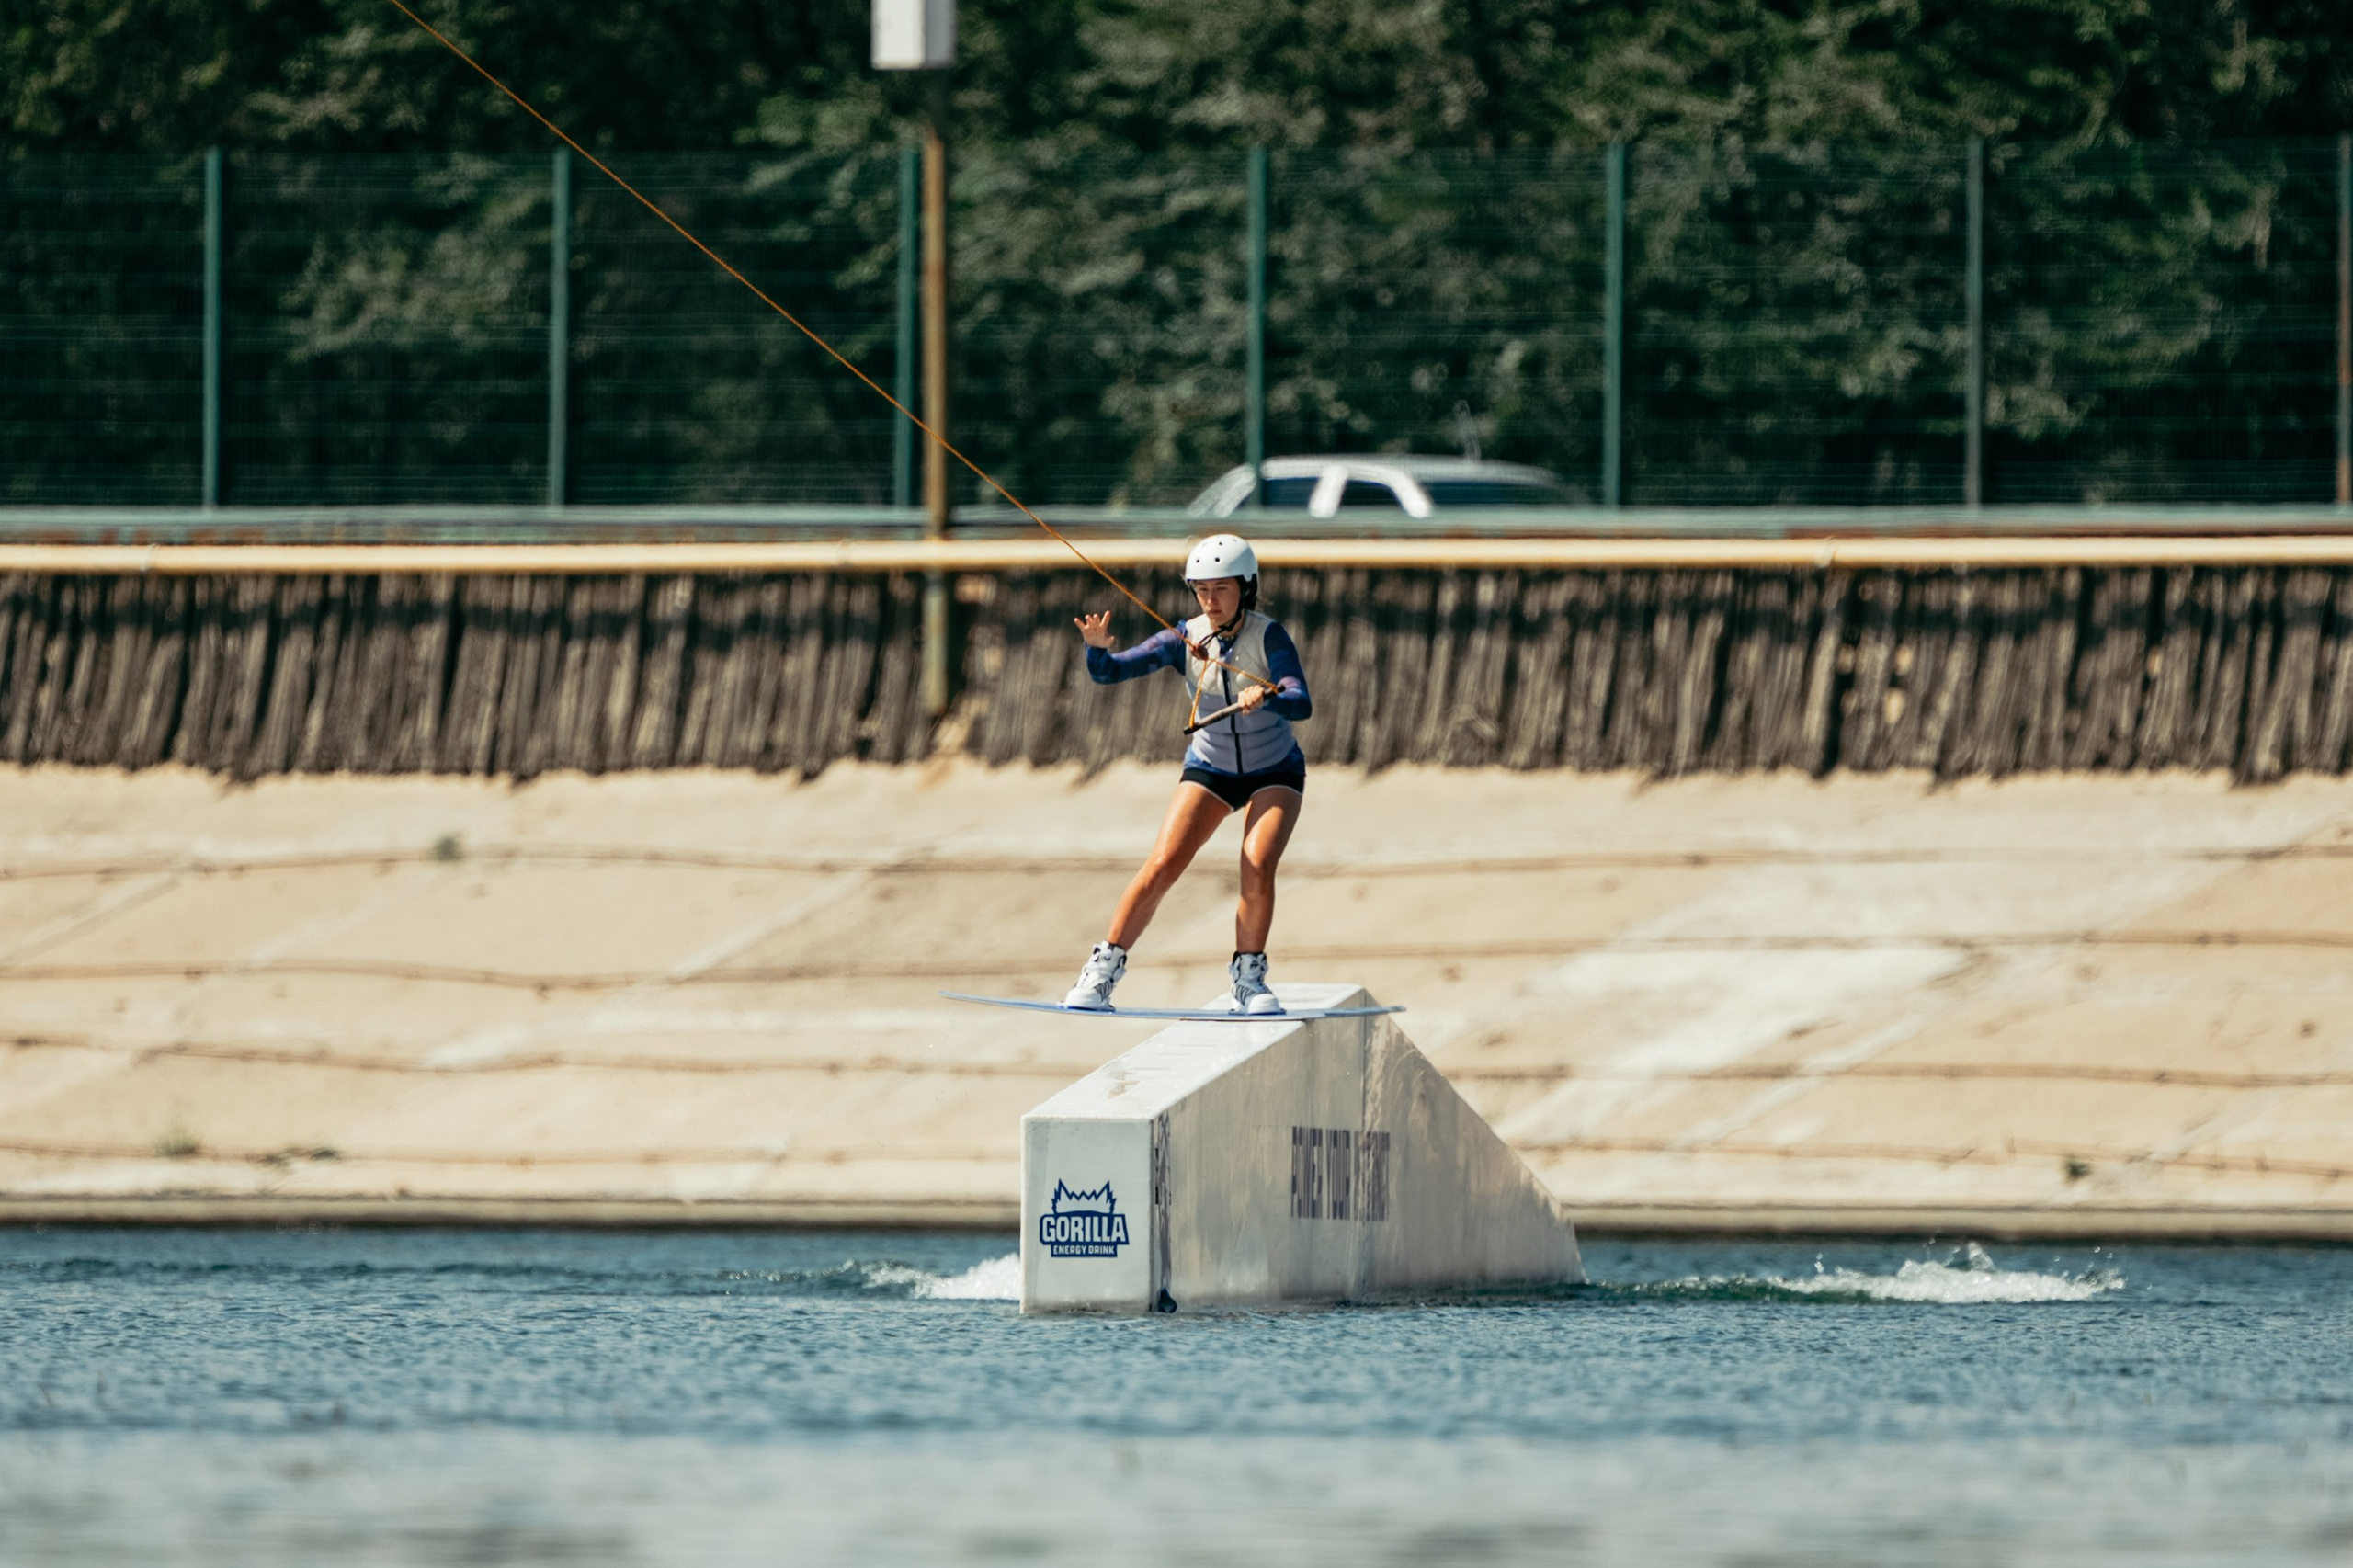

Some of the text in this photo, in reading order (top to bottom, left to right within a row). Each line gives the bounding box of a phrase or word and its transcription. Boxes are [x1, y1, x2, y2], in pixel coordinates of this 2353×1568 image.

[1041, 1215, 1127, 1243] GORILLA
[1053, 1245, 1115, 1255] ENERGY DRINK
